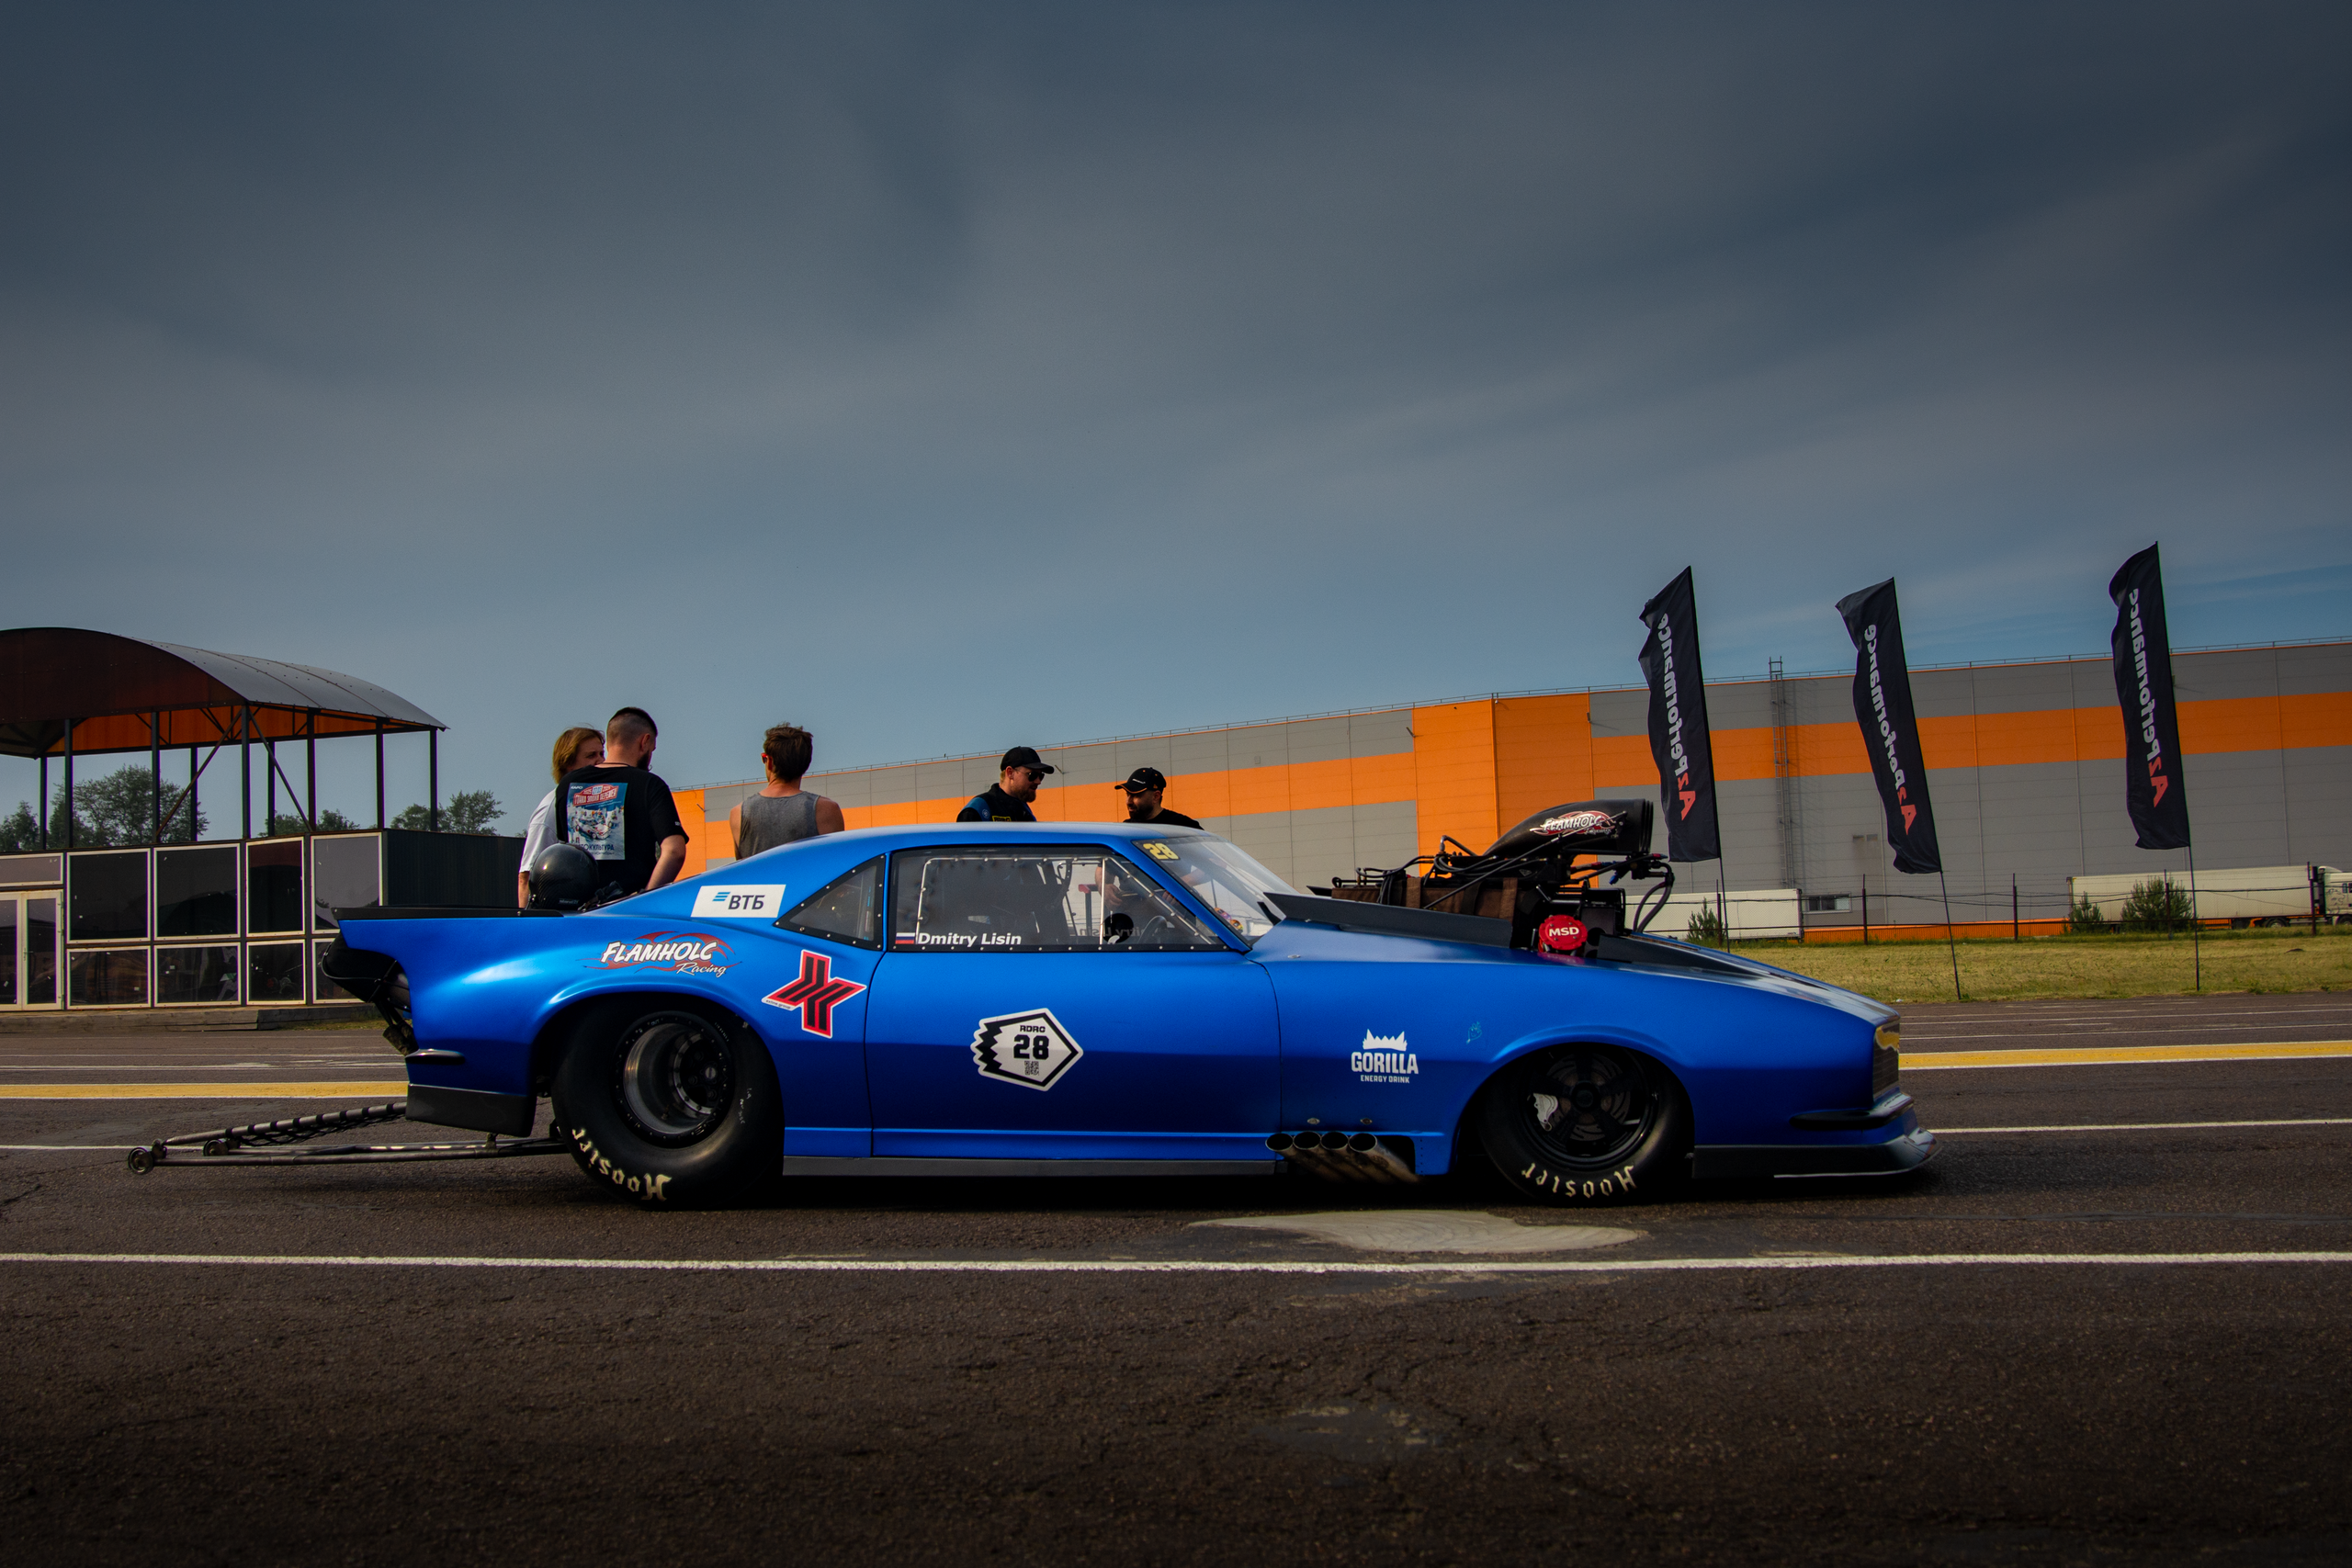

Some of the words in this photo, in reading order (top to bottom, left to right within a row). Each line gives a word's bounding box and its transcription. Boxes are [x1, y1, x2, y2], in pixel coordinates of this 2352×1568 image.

[1143, 843, 1179, 860] 28
[728, 895, 765, 910] ВТБ
[918, 932, 978, 947] Dmitry
[981, 932, 1022, 945] Lisin
[1549, 927, 1579, 937] MSD
[676, 962, 727, 977] Racing
[1013, 1034, 1049, 1060] 28
[1351, 1052, 1419, 1074] GORILLA
[571, 1128, 673, 1201] Hoosier
[1521, 1162, 1637, 1199] Hoosier
